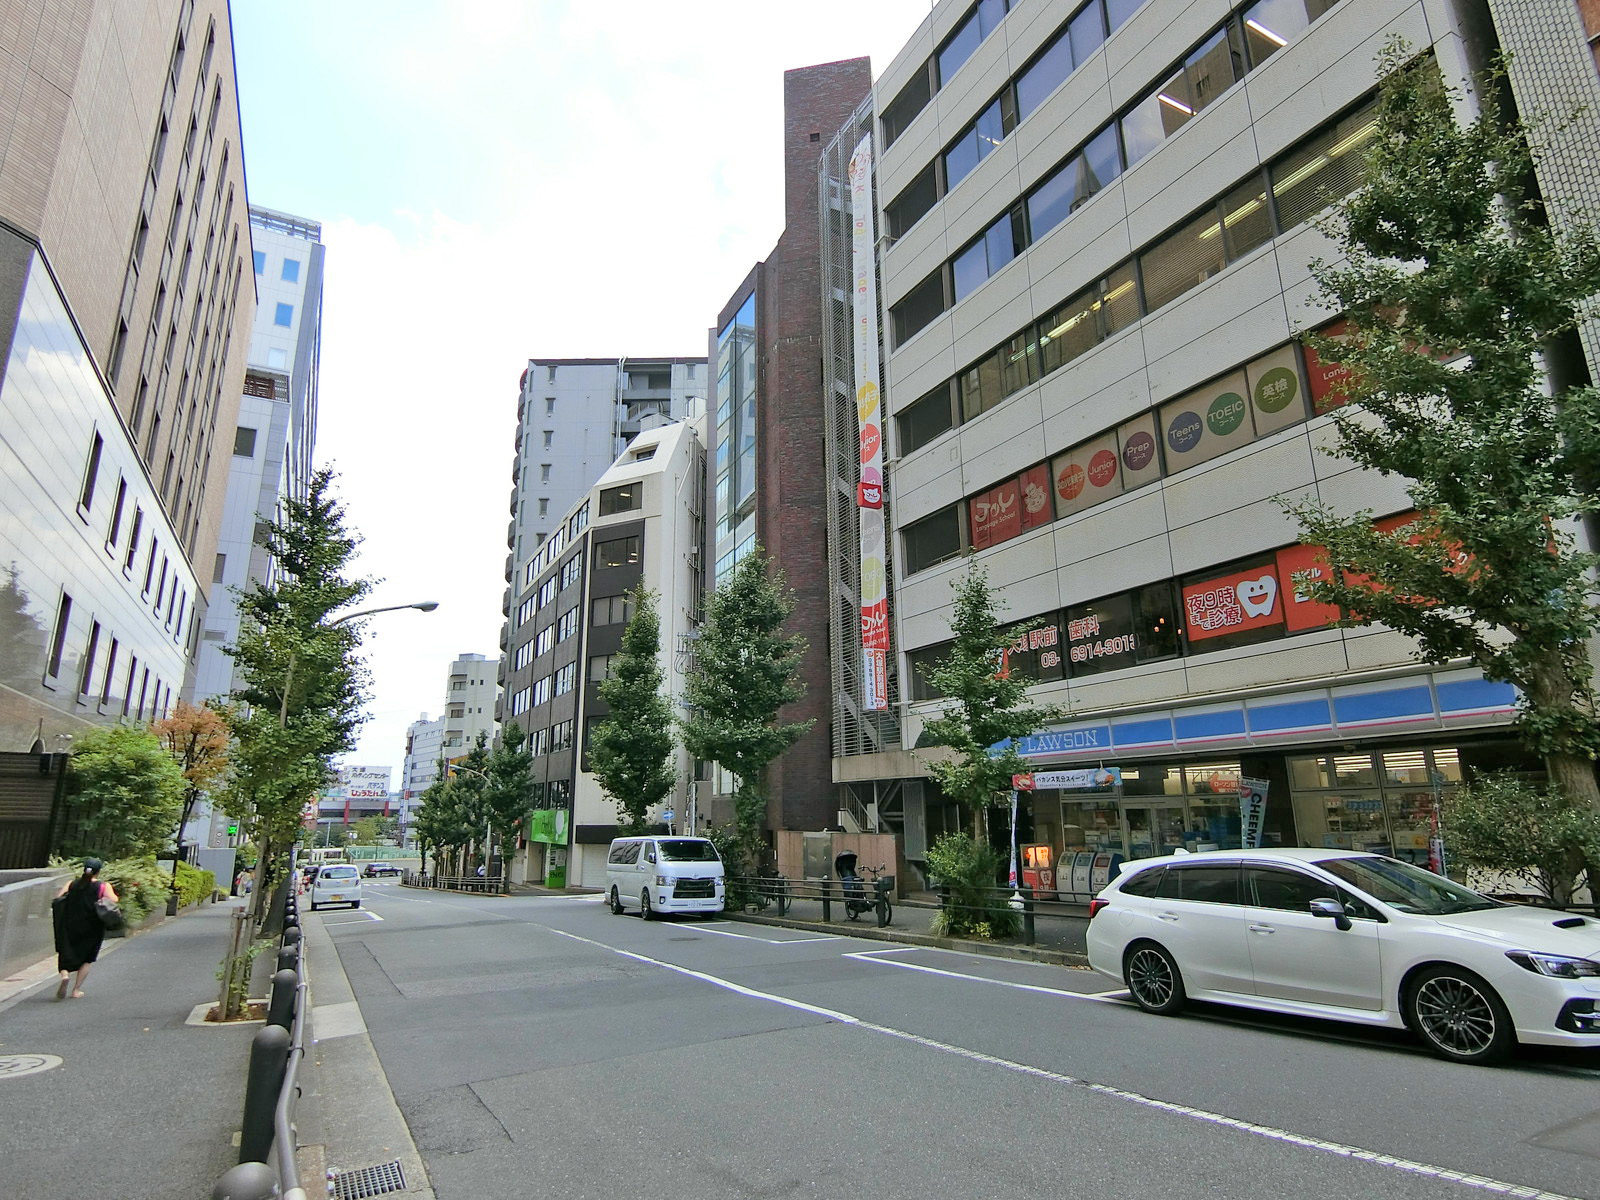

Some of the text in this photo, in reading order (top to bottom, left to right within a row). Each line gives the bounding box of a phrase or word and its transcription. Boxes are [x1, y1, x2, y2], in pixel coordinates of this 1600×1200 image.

[1322, 365, 1348, 380] Lang
[1268, 392, 1285, 404] コース
[1208, 400, 1243, 422] TOEIC
[1218, 416, 1235, 427] コース
[1170, 422, 1200, 440] Teens
[1179, 434, 1193, 444] コース
[1127, 442, 1149, 458] Prep
[1089, 459, 1115, 476] Junior
[975, 492, 1015, 522] JOY
[976, 511, 1015, 532] Language School
[1187, 585, 1235, 613] 夜9時
[1190, 605, 1243, 631] まで診療
[1068, 614, 1100, 641] 歯科
[1041, 651, 1060, 668] 03-
[1027, 730, 1098, 752] LAWSON
